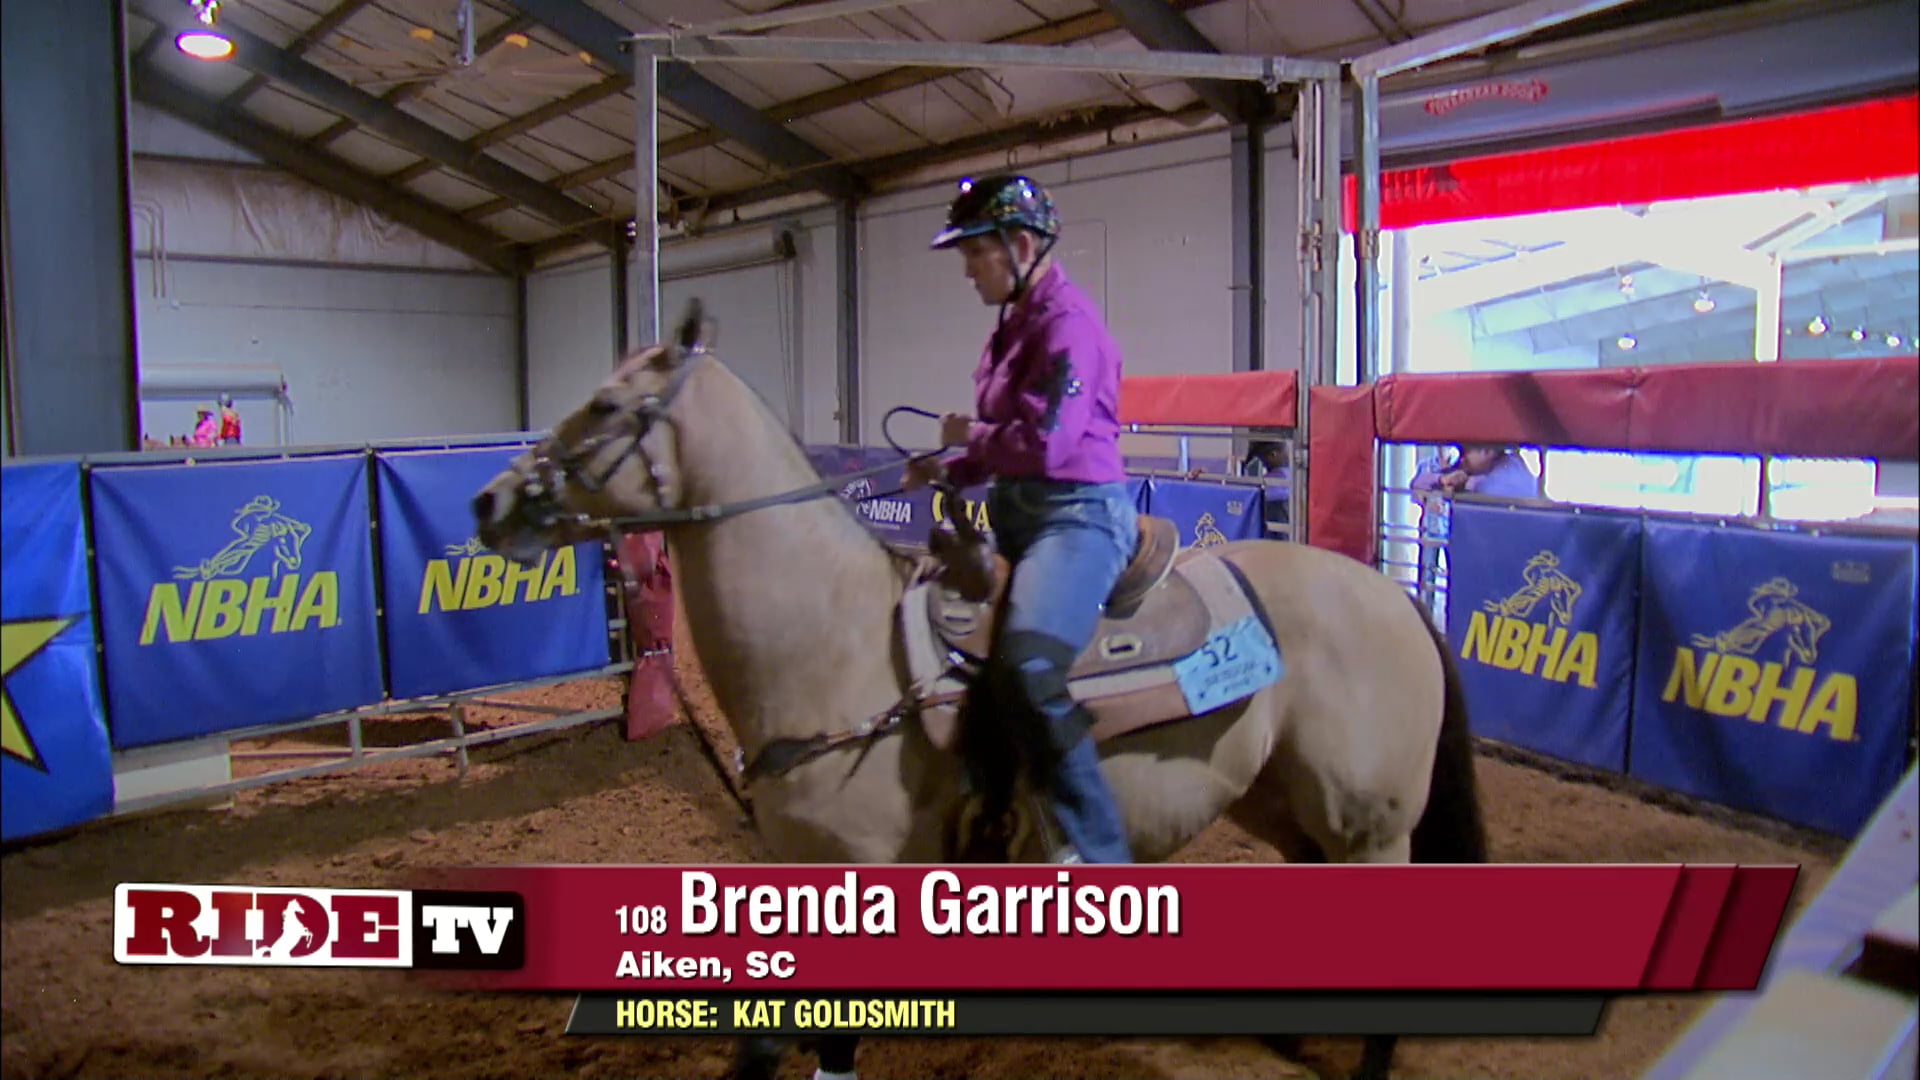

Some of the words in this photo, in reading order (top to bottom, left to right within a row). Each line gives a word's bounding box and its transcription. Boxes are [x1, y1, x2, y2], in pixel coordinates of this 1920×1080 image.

[869, 499, 911, 523] NBHA
[139, 571, 338, 645] NBHA
[419, 545, 576, 614] NBHA
[1461, 610, 1597, 688] NBHA
[1661, 645, 1858, 742] NBHA
